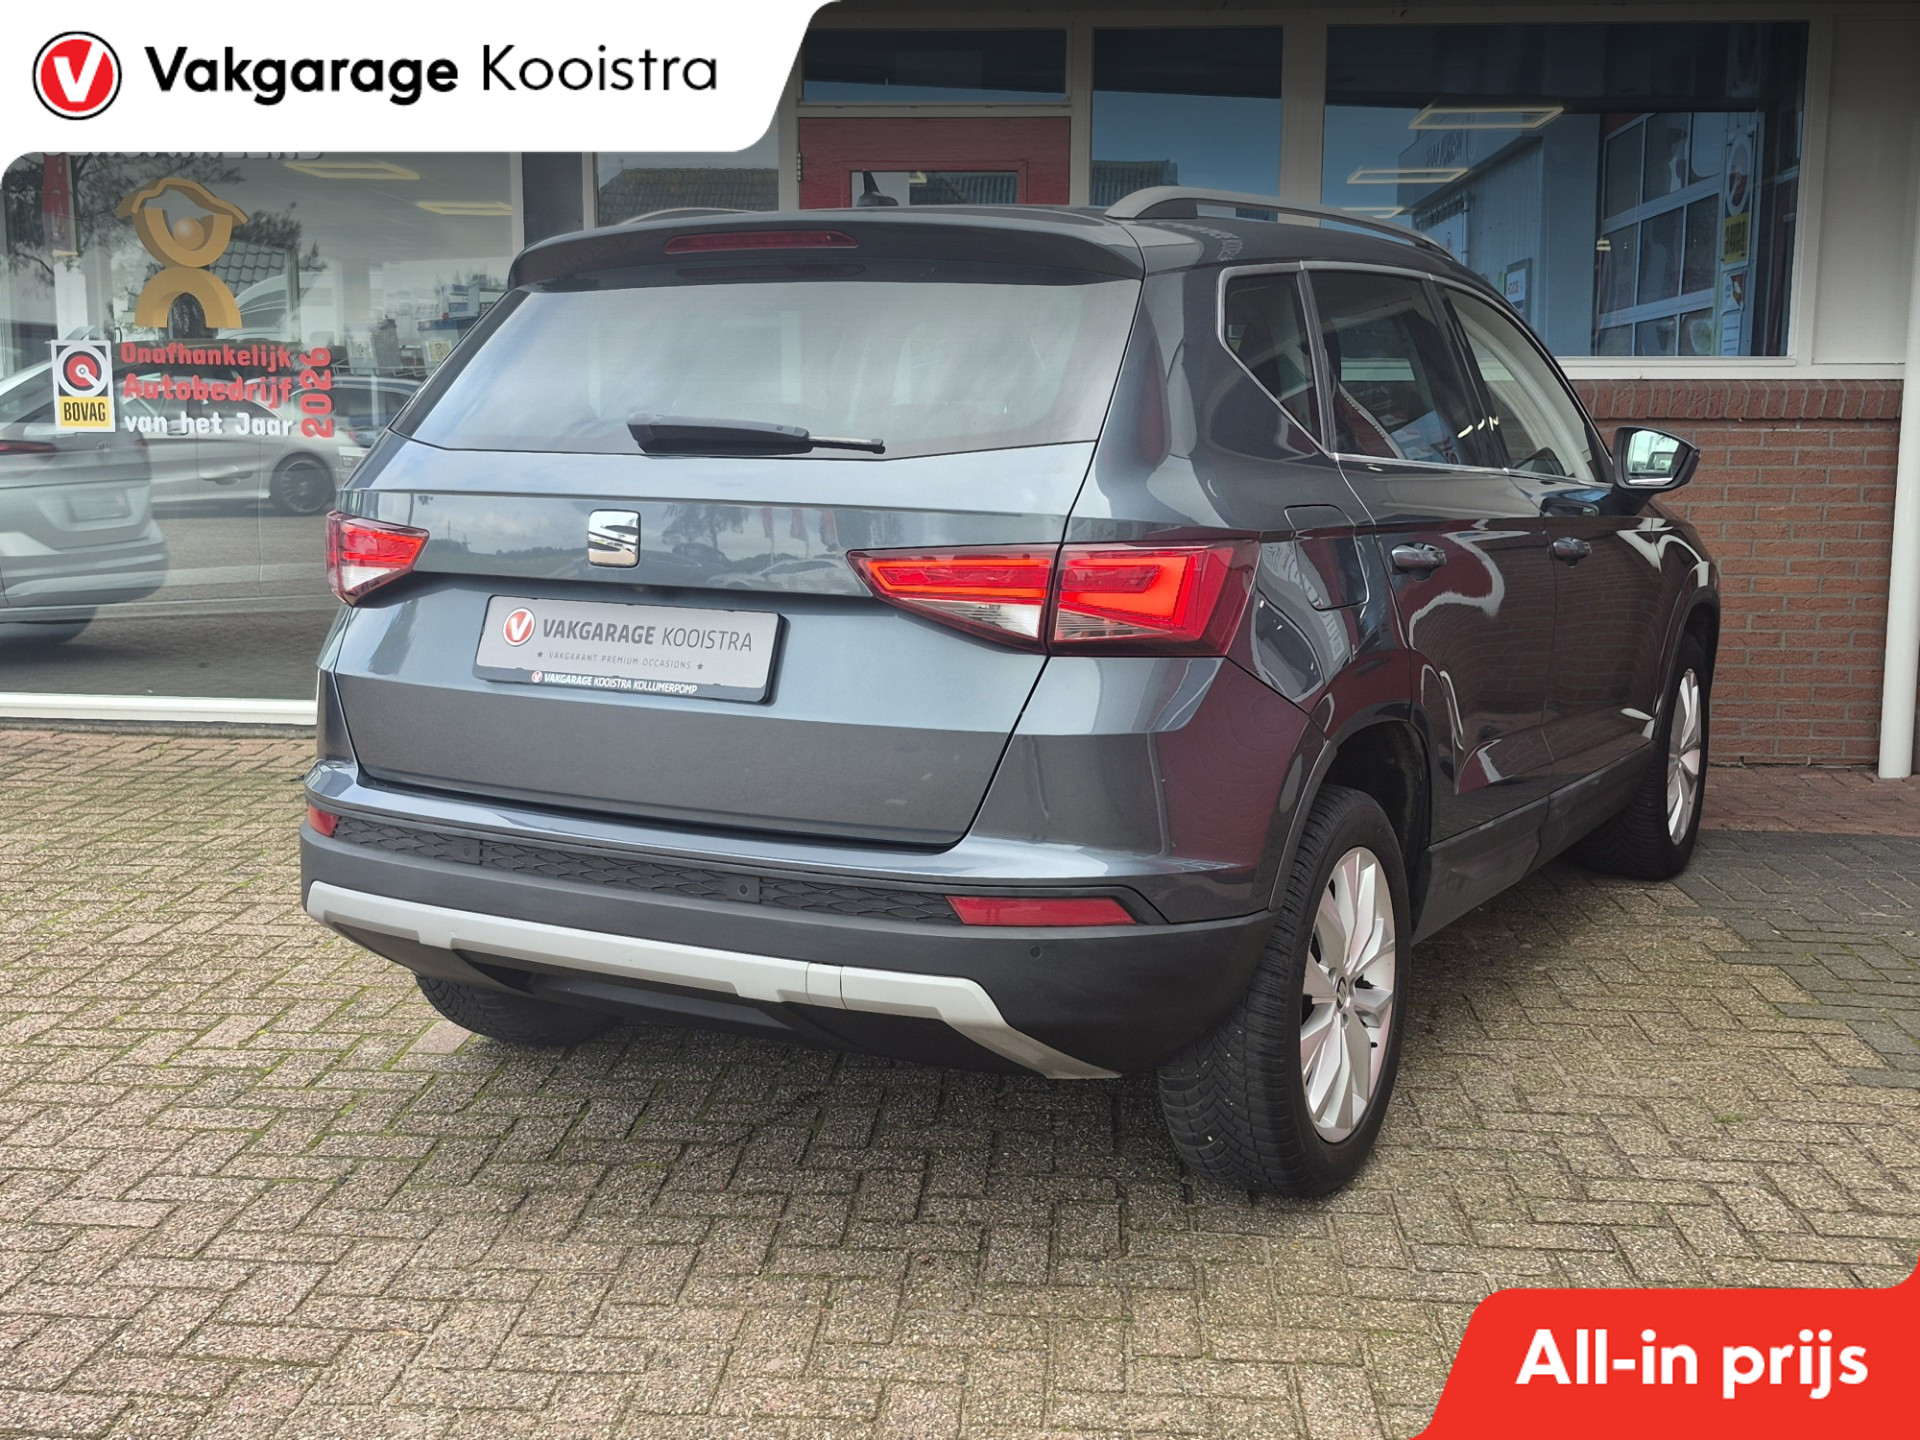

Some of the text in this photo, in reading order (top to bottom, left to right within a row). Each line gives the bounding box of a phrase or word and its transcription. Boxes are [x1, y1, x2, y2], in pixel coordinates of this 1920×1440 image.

[121, 341, 291, 373] Onafhankelijk
[122, 372, 293, 409] Autobedrijf
[300, 346, 334, 439] 2026
[63, 401, 107, 423] BOVAG
[124, 410, 294, 437] van het Jaar
[543, 618, 656, 645] VAKGARAGE
[661, 627, 752, 652] KOOISTRA
[549, 651, 692, 670] VAKGARANT PREMIUM OCCASIONS
[544, 672, 593, 686] VAKGARAGE
[593, 678, 632, 690] KOOISTRA
[633, 680, 698, 695] KOLLUMERPOMP
